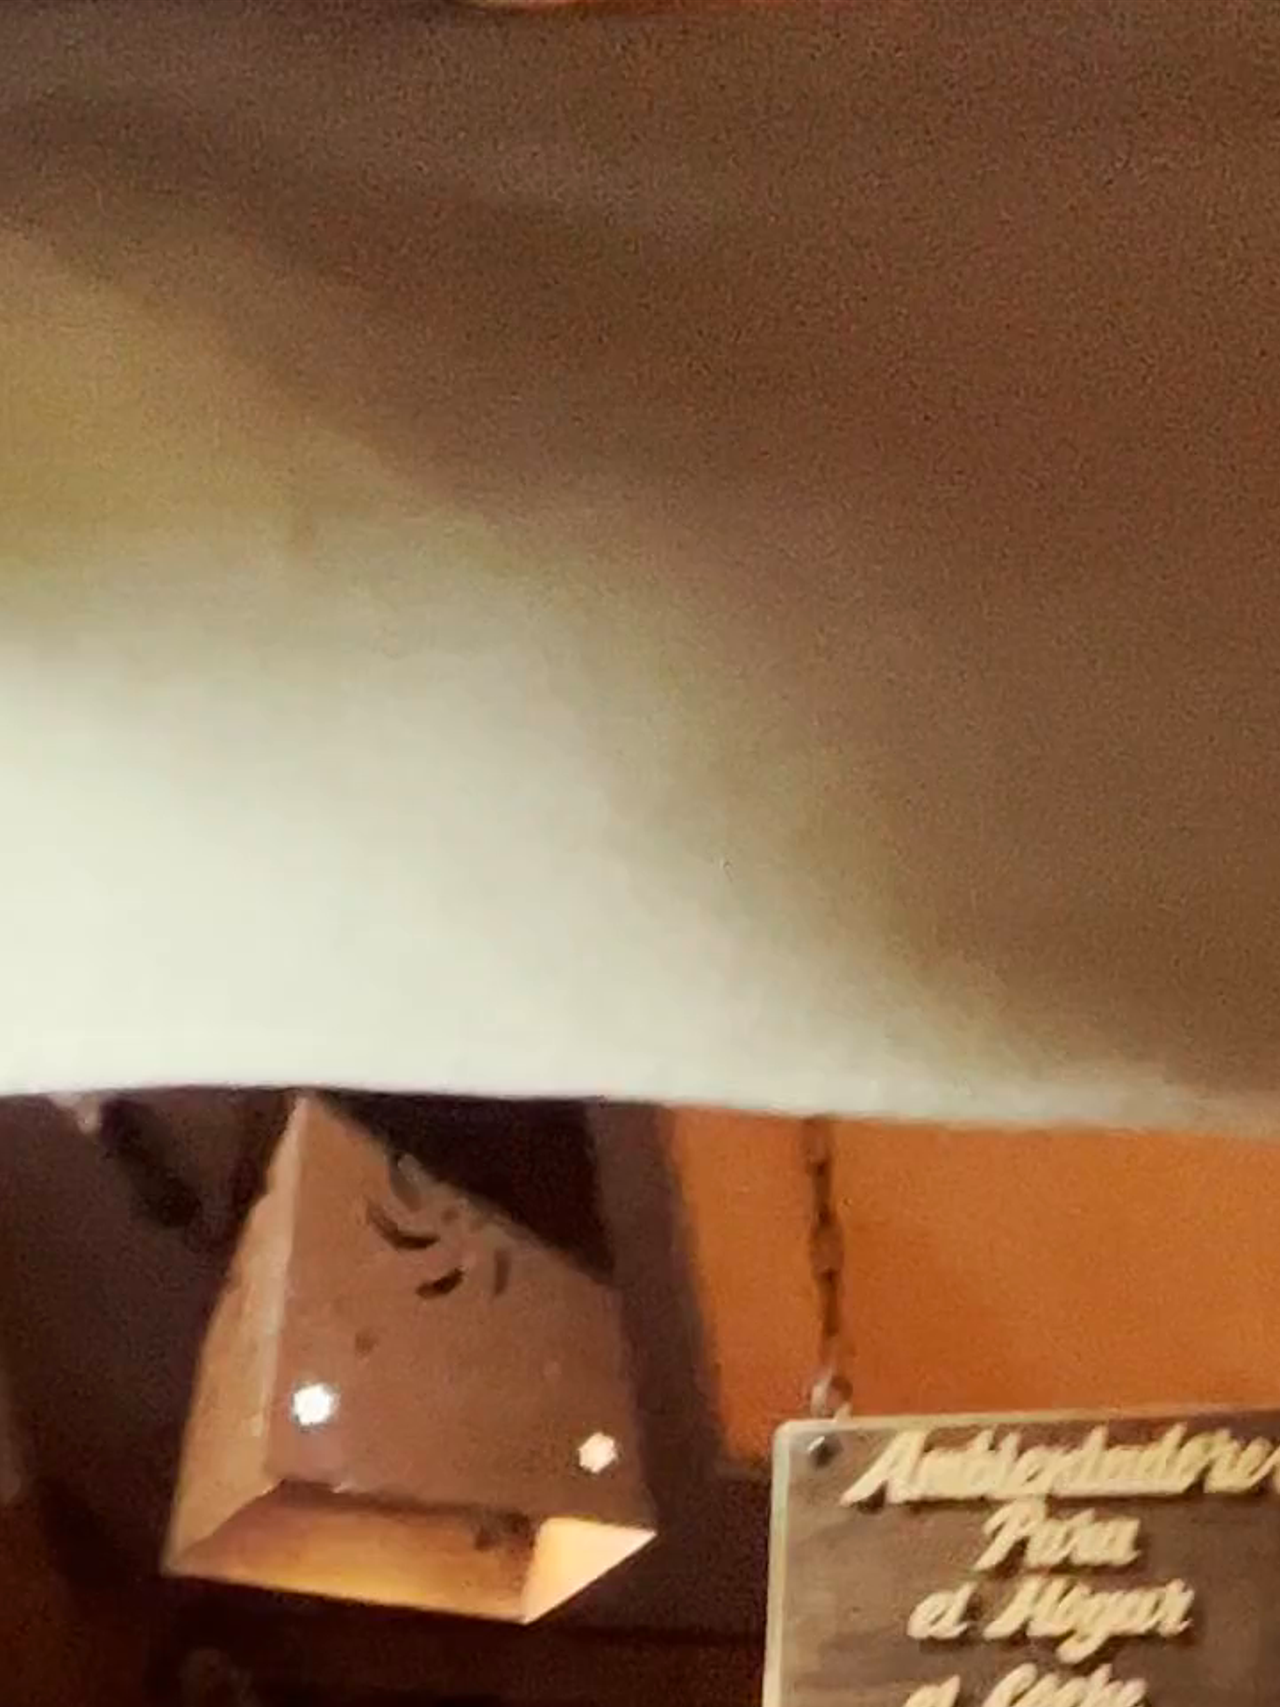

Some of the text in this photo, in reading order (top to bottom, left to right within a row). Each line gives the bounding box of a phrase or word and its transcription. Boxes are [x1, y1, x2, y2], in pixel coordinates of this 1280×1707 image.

[971, 1496, 1141, 1572] Para
[907, 1574, 1195, 1664] el Hogar
